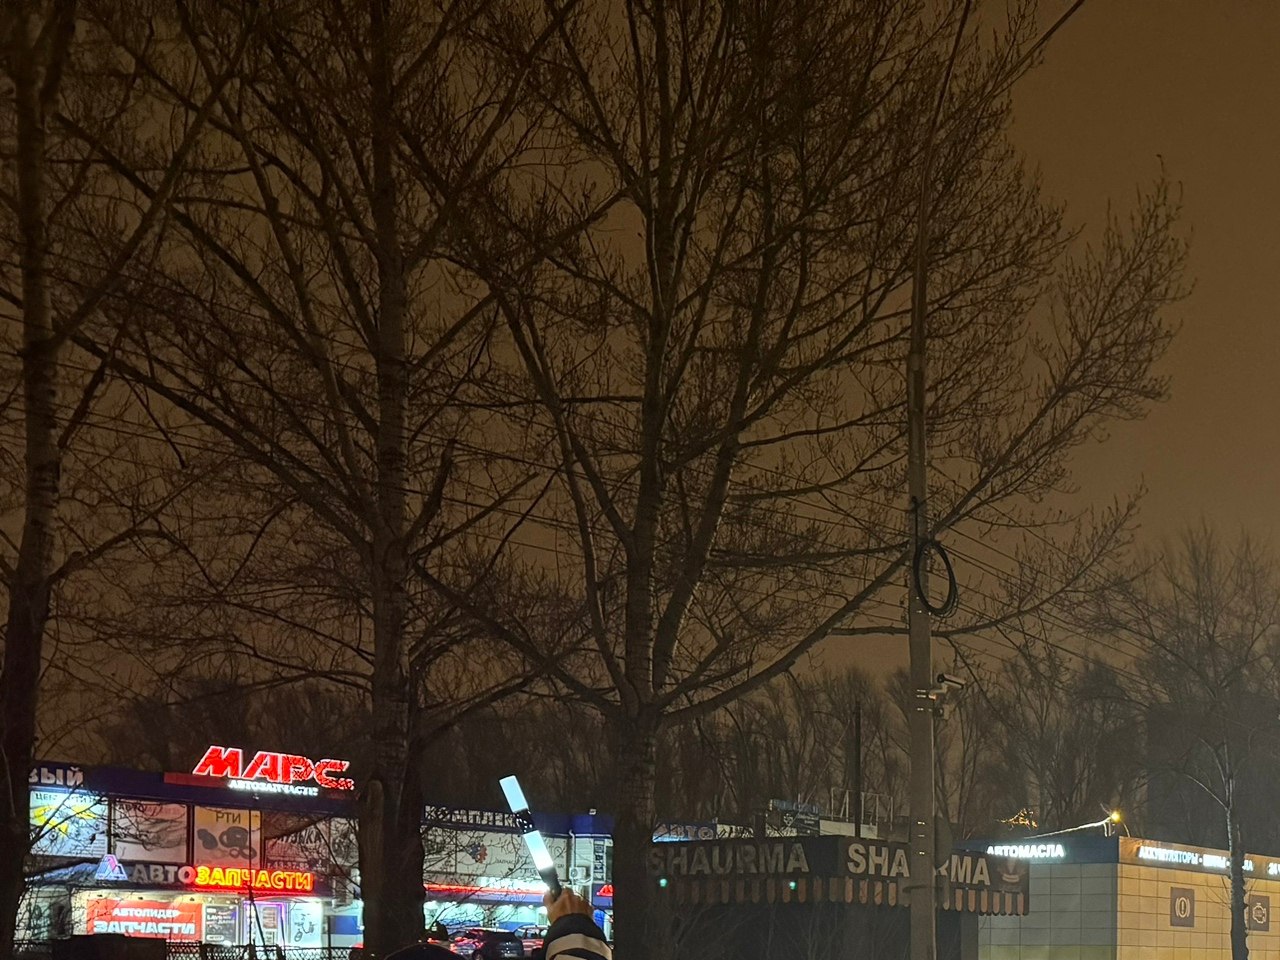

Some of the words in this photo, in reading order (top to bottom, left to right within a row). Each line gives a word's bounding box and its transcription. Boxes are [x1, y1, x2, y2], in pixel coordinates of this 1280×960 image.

[192, 745, 354, 791] МАРС
[215, 811, 241, 824] РТИ
[987, 844, 1064, 858] АВТОМАСЛА
[93, 921, 195, 935] ЗАПЧАСТИ
